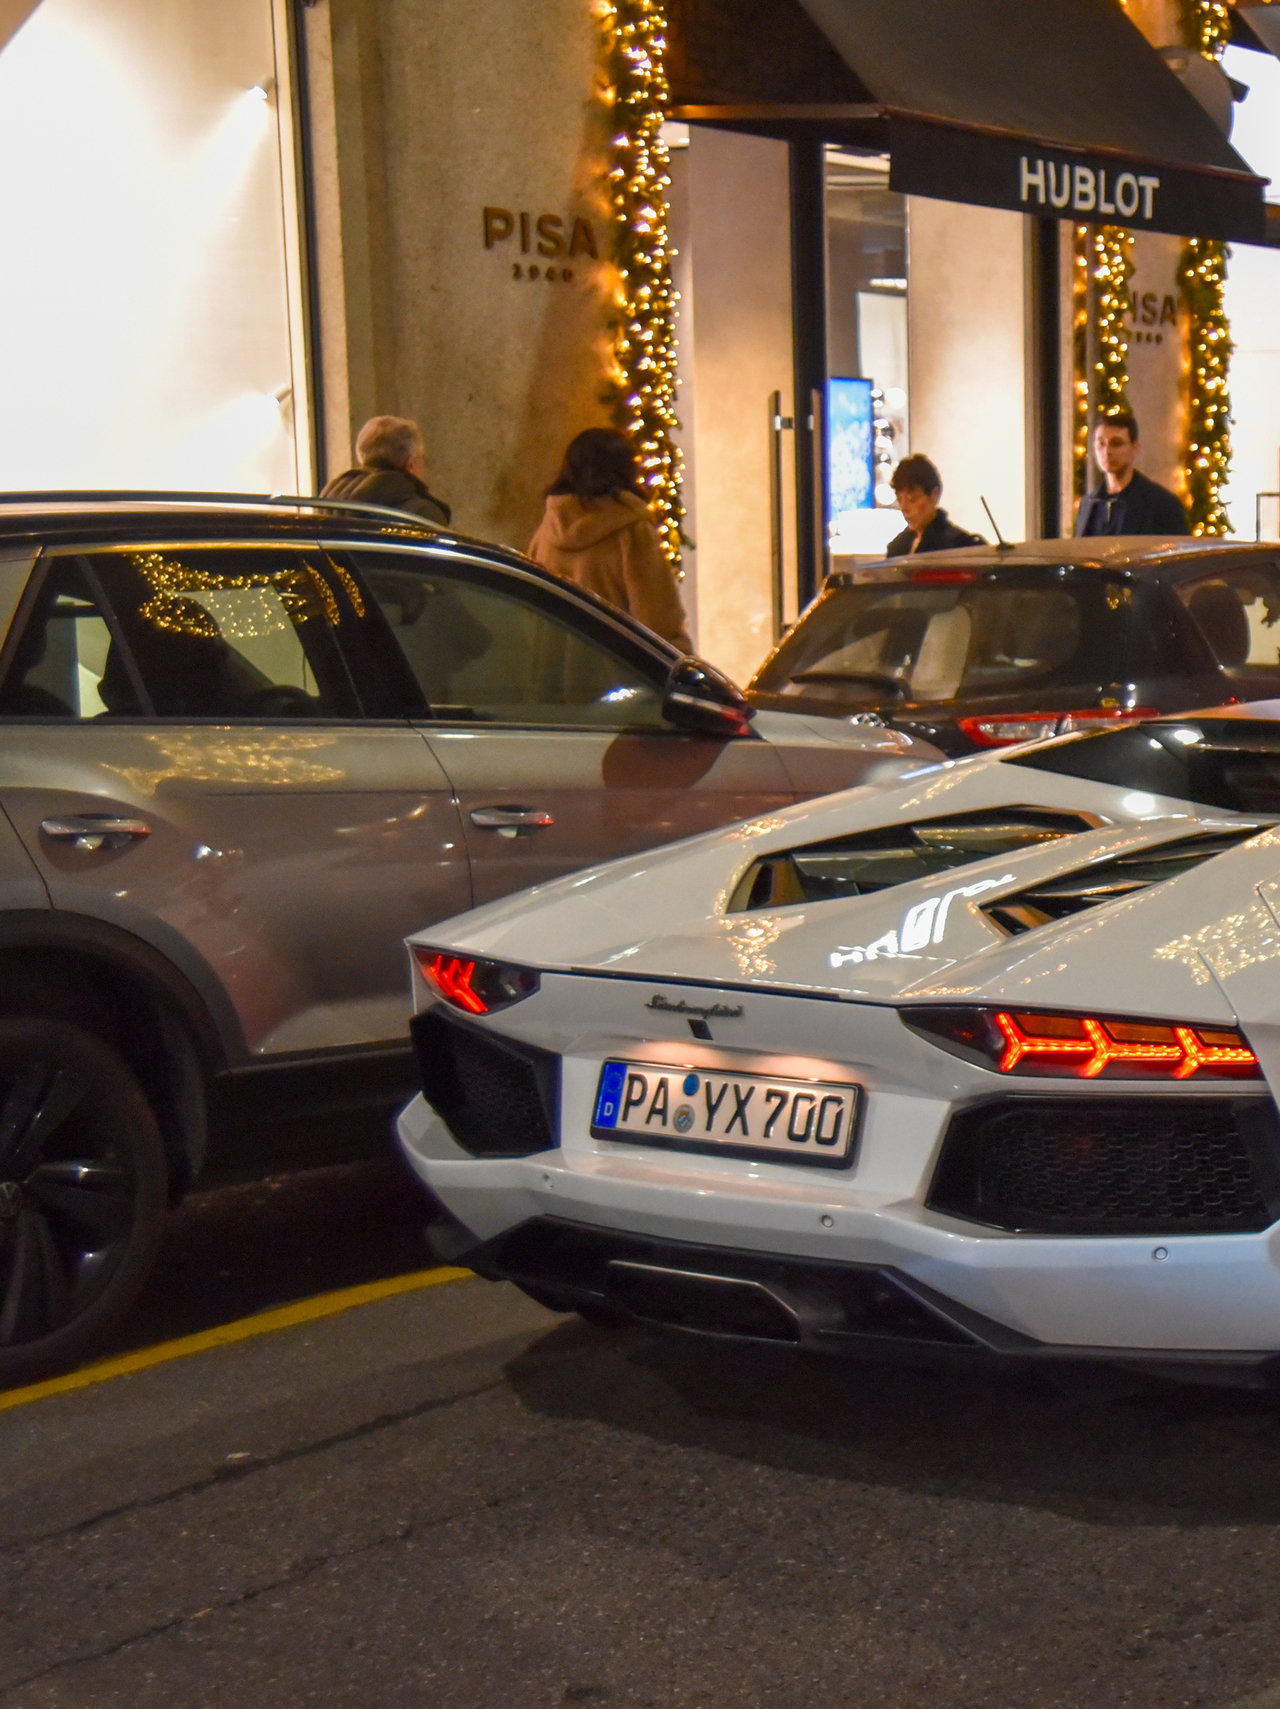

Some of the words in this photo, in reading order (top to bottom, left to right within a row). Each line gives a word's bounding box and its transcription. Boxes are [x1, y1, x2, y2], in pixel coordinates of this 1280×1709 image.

[1020, 156, 1160, 219] HUBLOT
[483, 206, 599, 260] PISA
[1130, 291, 1177, 328] ISA
[603, 1102, 613, 1117] D
[621, 1073, 669, 1127] PA
